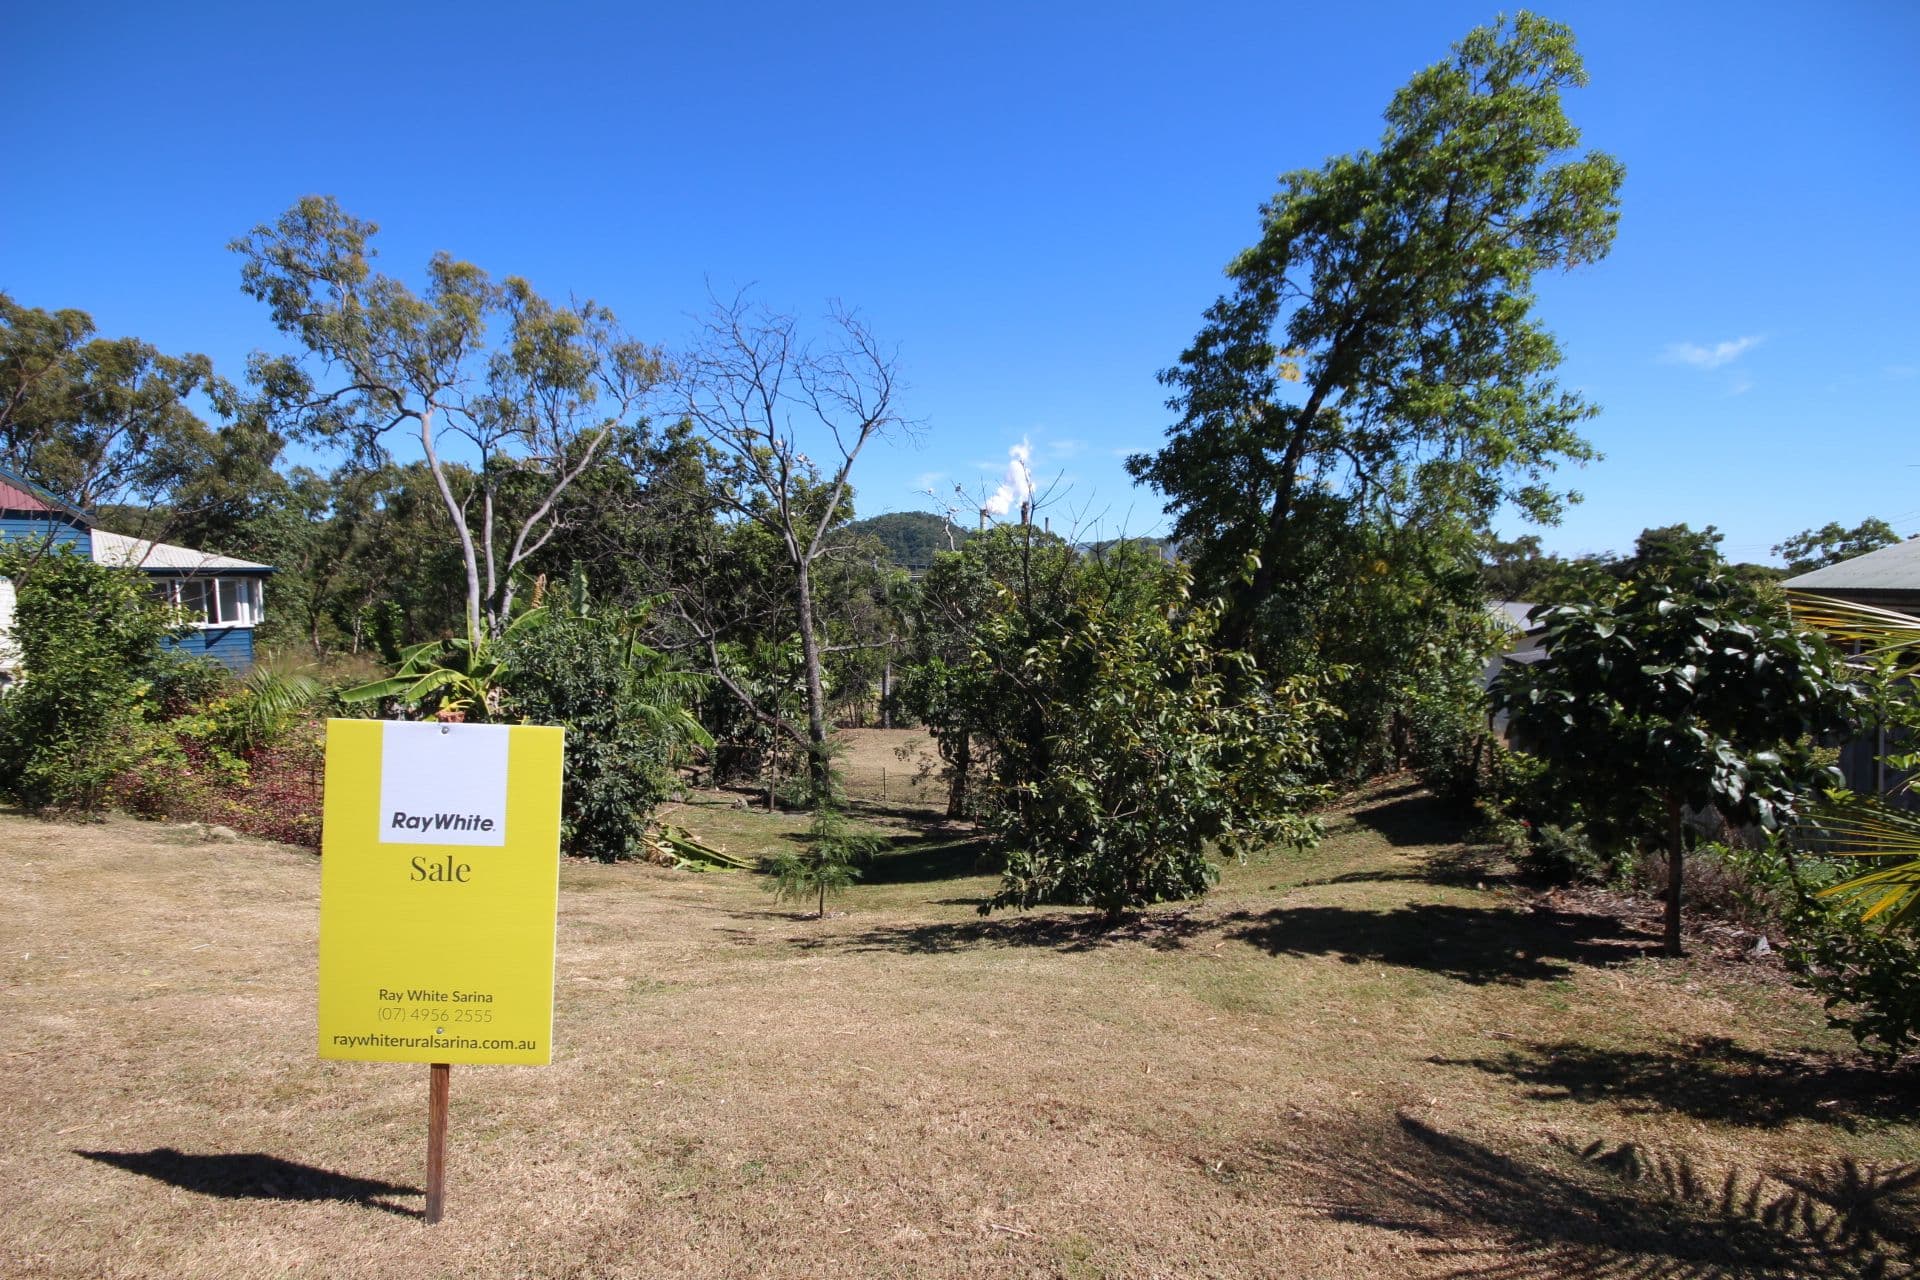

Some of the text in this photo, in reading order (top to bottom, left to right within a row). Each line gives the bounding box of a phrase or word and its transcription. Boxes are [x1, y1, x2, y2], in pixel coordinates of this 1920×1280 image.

[410, 855, 472, 883] Sale
[379, 988, 493, 1003] Ray White Sarina
[378, 1007, 493, 1023] (07) 4956 2555
[333, 1033, 536, 1050] raywhiteruralsarina.com.au
